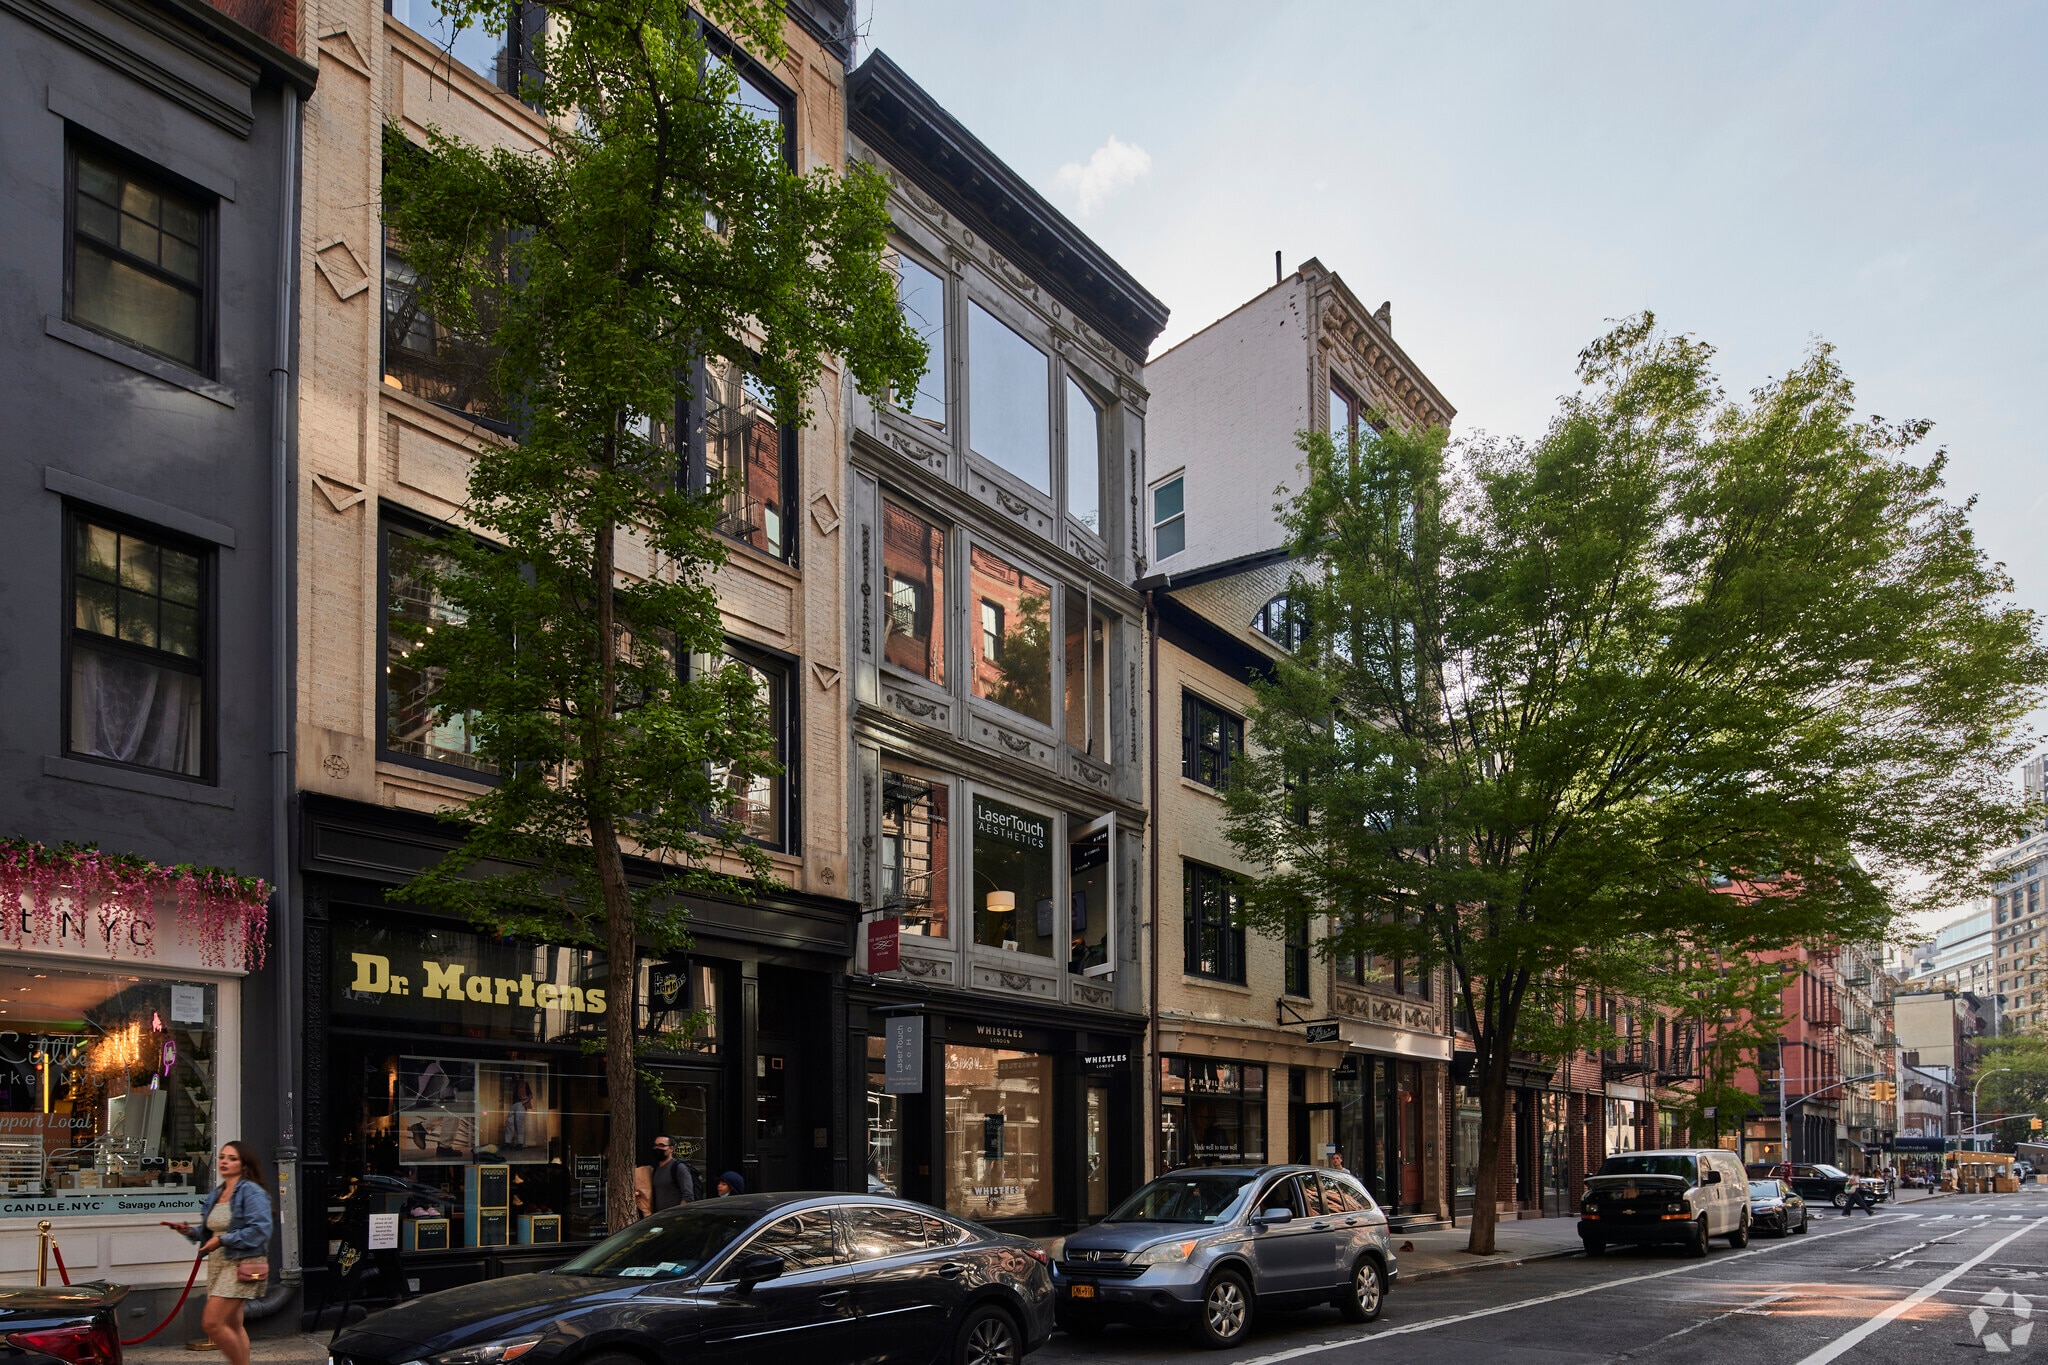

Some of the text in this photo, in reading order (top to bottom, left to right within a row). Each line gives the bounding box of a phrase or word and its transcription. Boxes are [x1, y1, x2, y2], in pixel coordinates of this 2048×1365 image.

[978, 804, 1044, 837] LaserTouch
[978, 822, 1044, 848] AESTHETICS
[62, 911, 151, 946] NYC
[351, 952, 607, 1014] Dr. Martens
[976, 1025, 1024, 1038] WHISTLES
[896, 1025, 904, 1073] LaserTouch
[1084, 1054, 1127, 1064] WHISTLES
[61, 1073, 105, 1088] NYC
[48, 1113, 93, 1129] Local
[974, 1186, 1020, 1196] WHISTLES
[4, 1200, 195, 1213] CANDLE.NYC Savage Anchor
